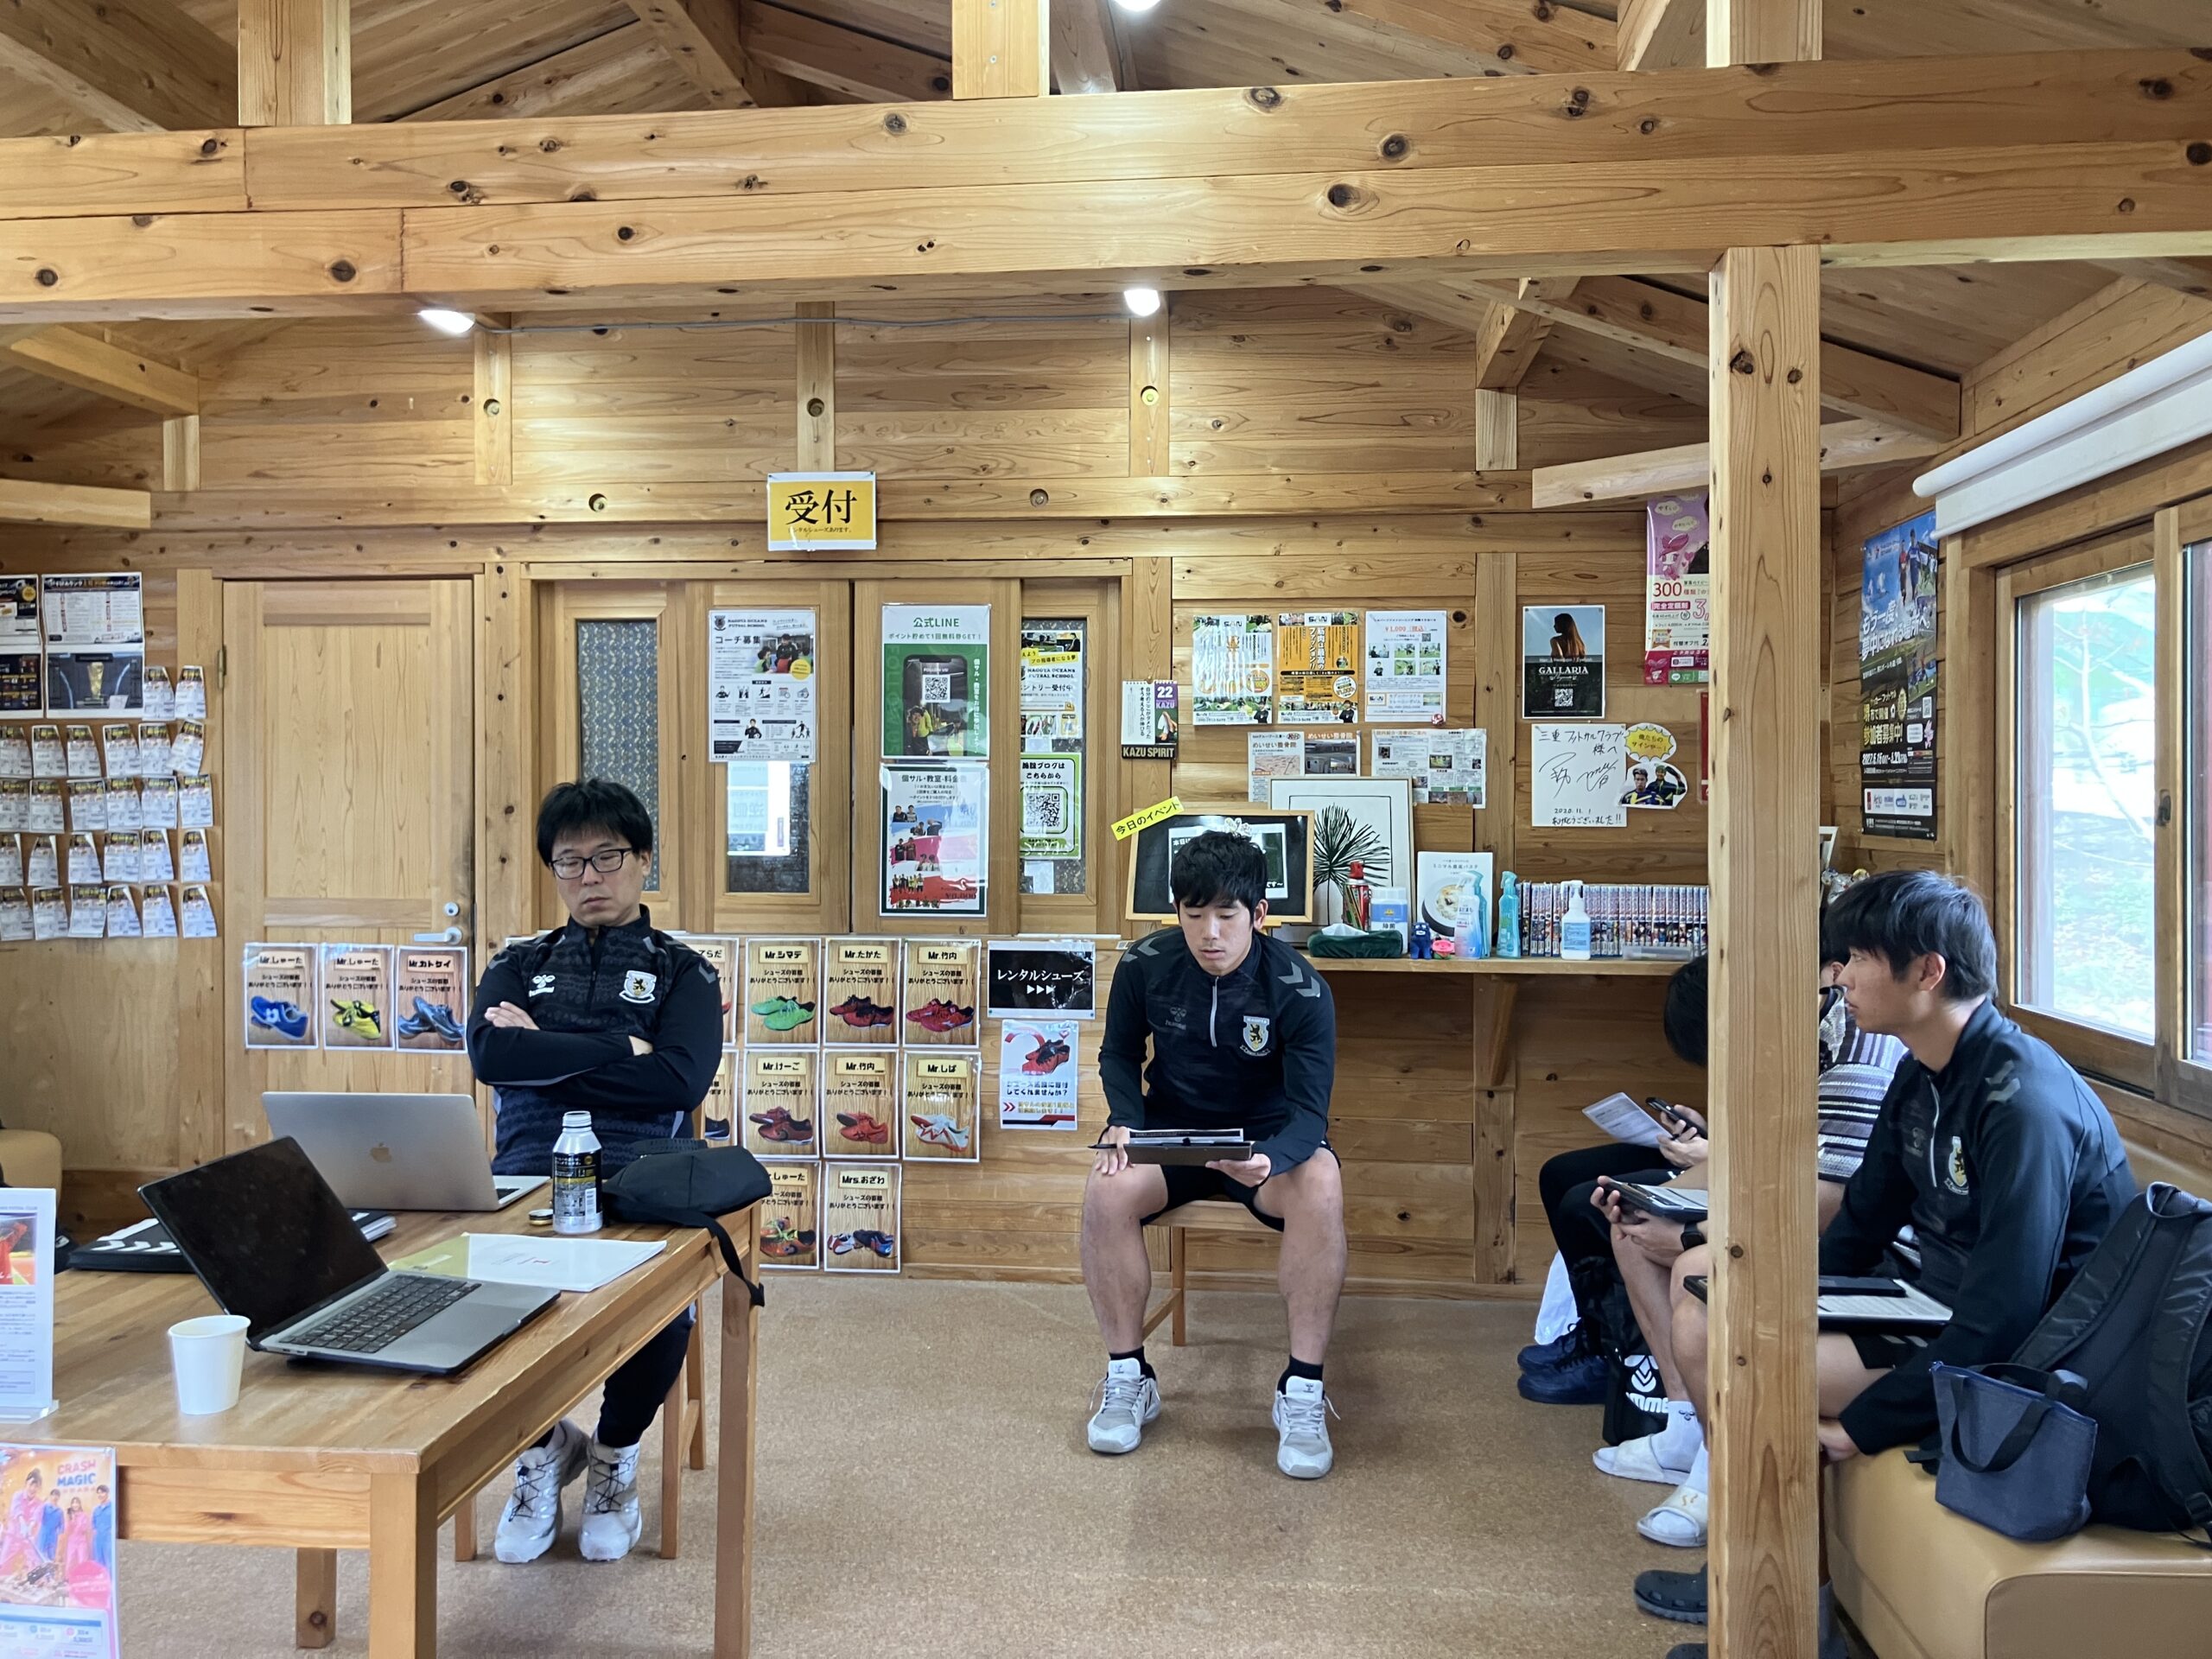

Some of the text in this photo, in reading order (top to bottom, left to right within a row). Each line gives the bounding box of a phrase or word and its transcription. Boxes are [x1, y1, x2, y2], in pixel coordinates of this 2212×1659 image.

[785, 489, 857, 525] 受付
[1652, 582, 1682, 597] 300
[913, 617, 960, 627] 公式LINE
[715, 635, 760, 645] コーチ募集
[1538, 666, 1589, 675] GALLARIA
[1157, 686, 1173, 699] 22
[1538, 728, 1561, 742] 三重
[1122, 747, 1175, 758] KAZU SPIRIT
[1592, 743, 1618, 756] 様へ
[1116, 801, 1180, 835] 今日のイベント
[765, 950, 803, 959] Mr.シマデ
[928, 951, 957, 961] Mr.竹内
[996, 969, 1085, 982] レンタルシューズ
[927, 1064, 957, 1073] Mr.しば
[57, 1459, 97, 1475] CRASH
[56, 1472, 97, 1487] MAGIC
